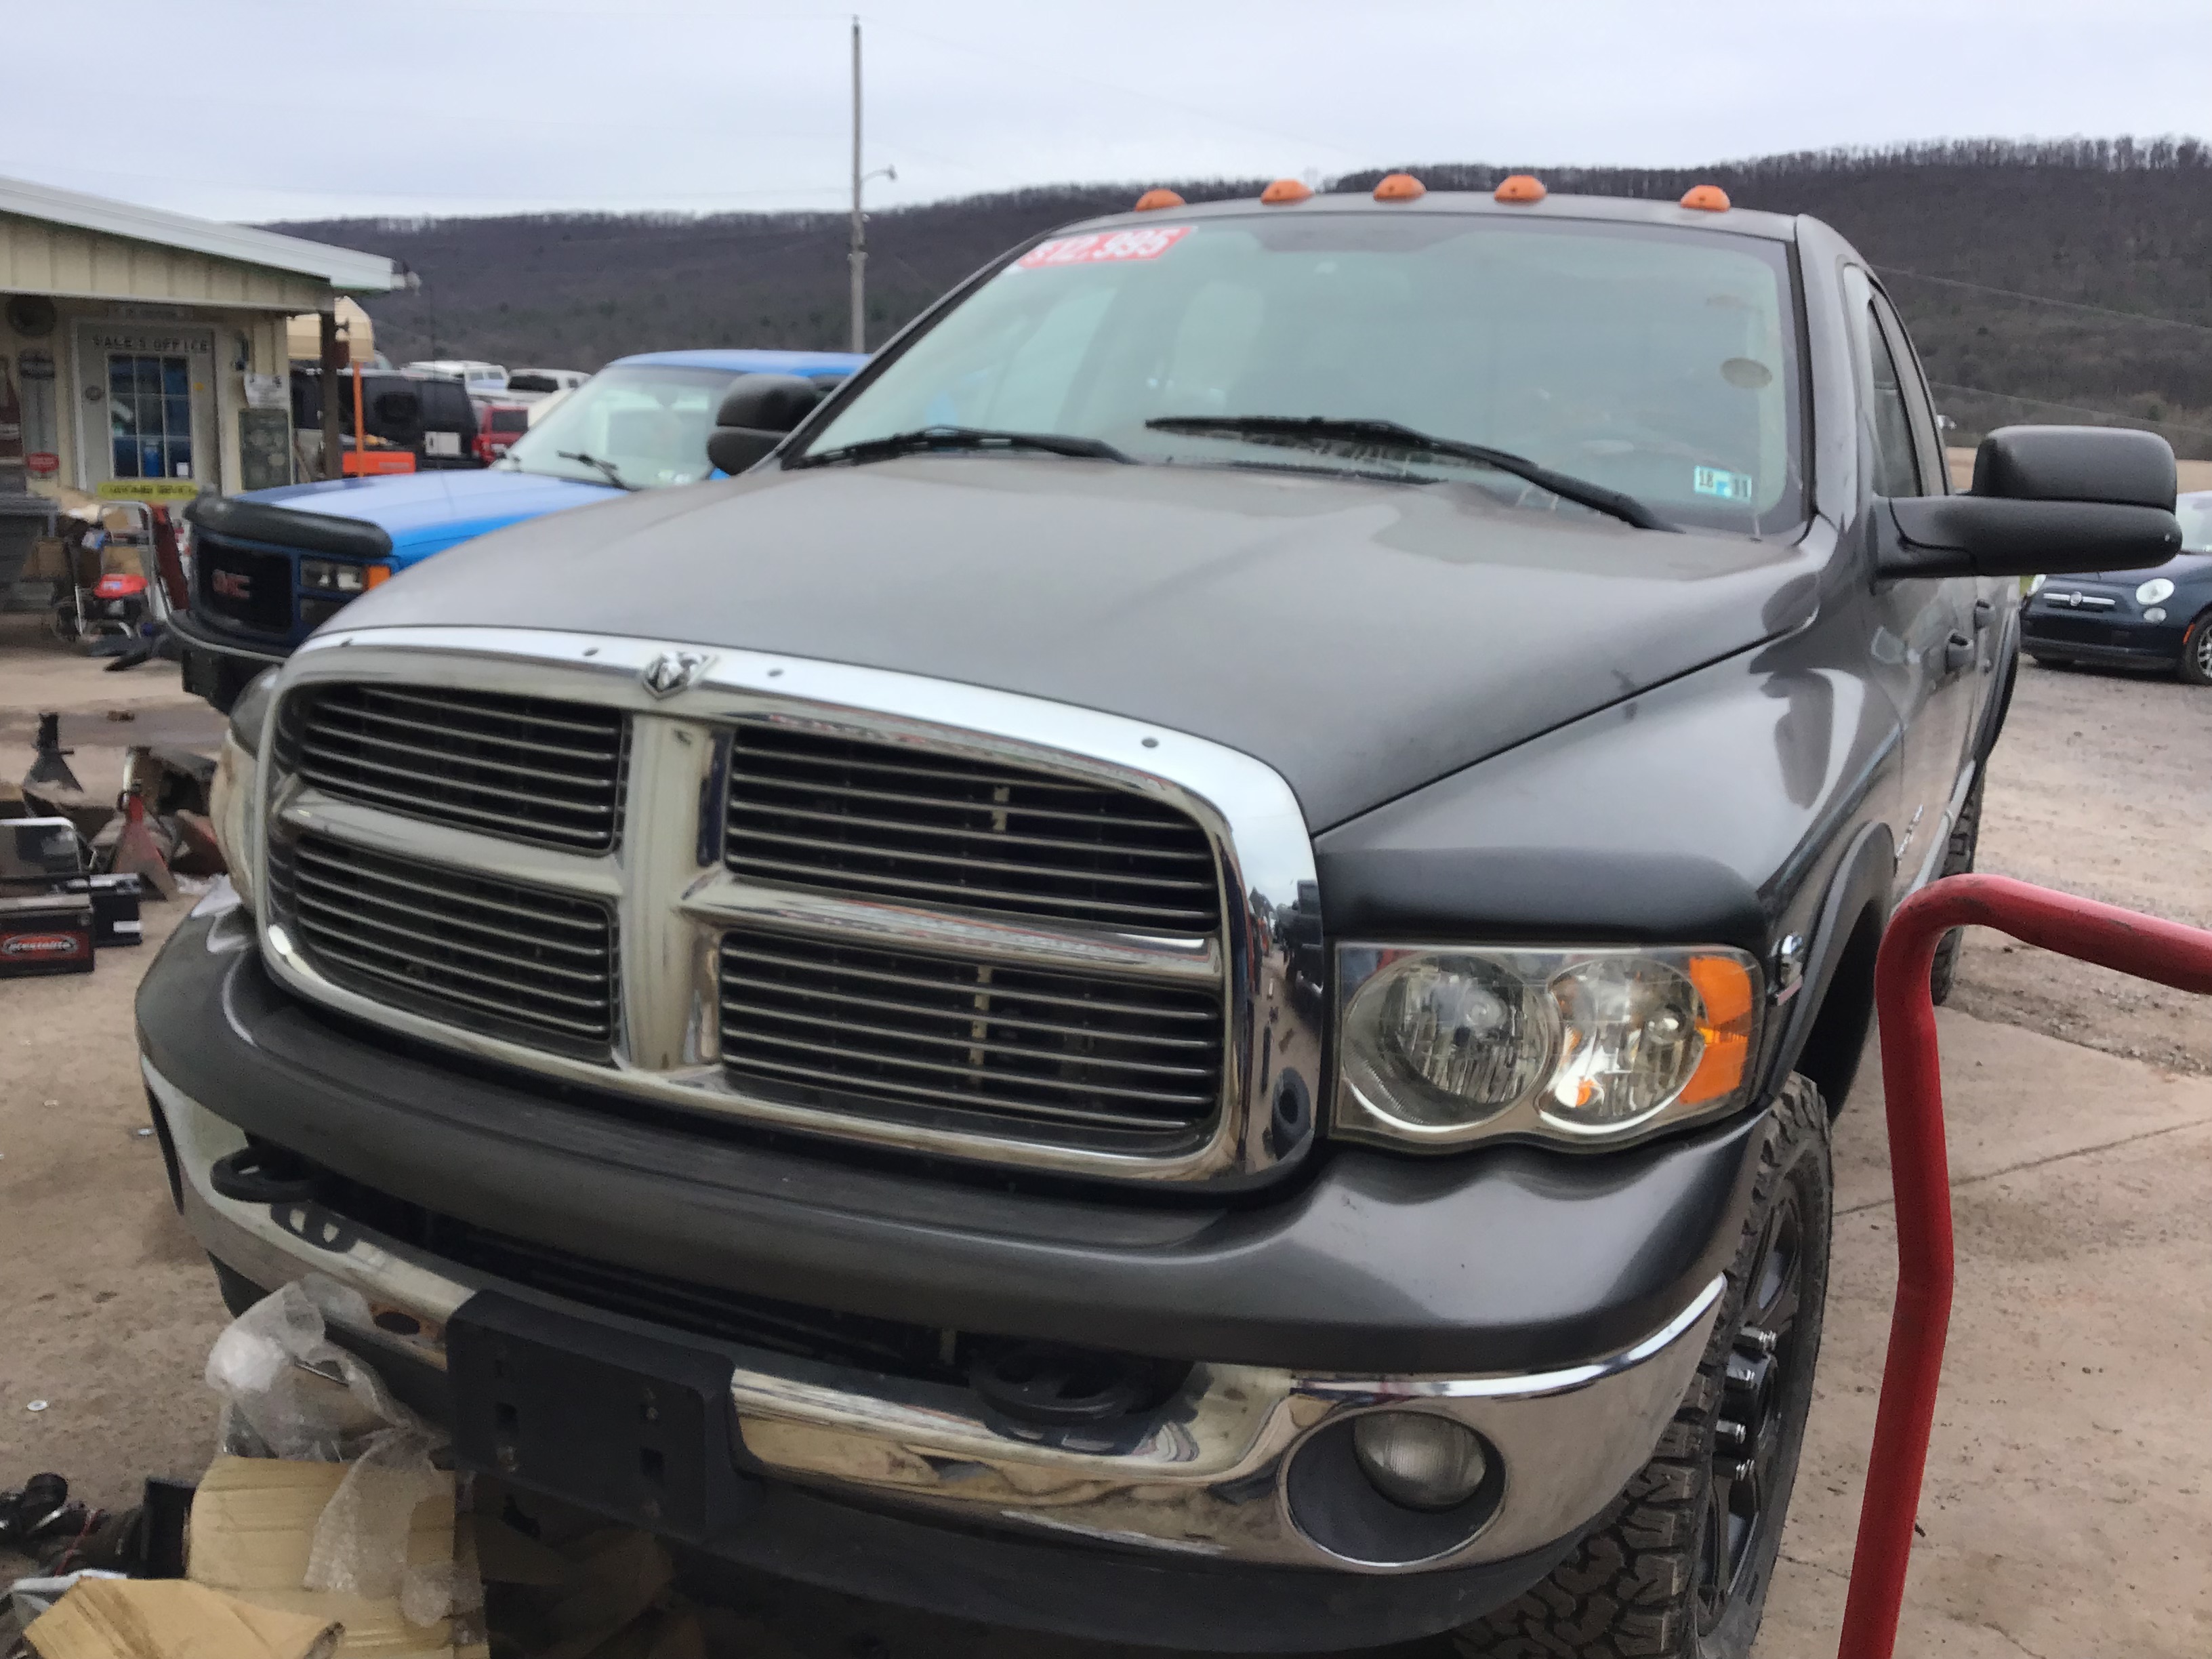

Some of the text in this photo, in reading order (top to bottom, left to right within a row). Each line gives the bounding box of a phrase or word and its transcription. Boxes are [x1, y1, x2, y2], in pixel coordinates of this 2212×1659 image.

[92, 335, 208, 354] SALES OFFICE
[211, 569, 250, 600] GMC
